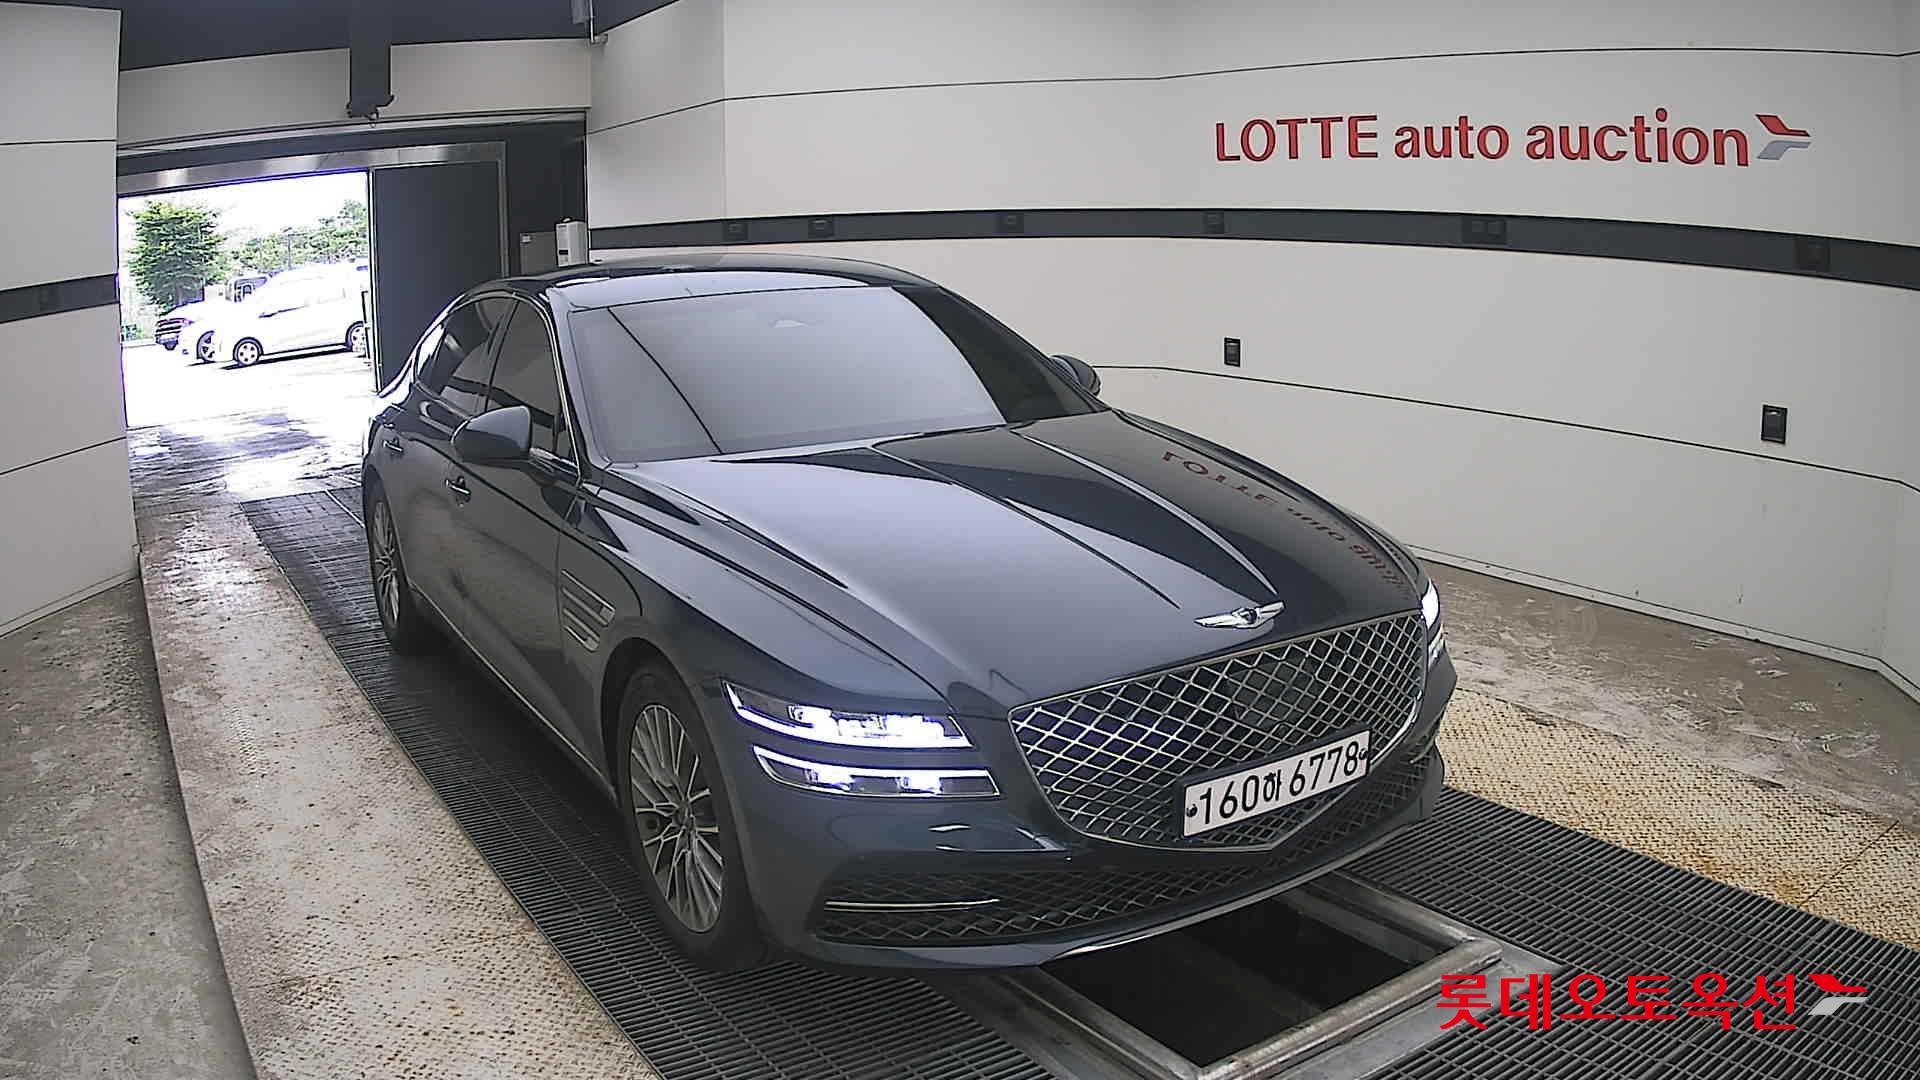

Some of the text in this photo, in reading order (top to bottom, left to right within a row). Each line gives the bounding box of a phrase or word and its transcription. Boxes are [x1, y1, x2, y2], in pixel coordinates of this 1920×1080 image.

[1216, 108, 1750, 167] LOTTE auto auction
